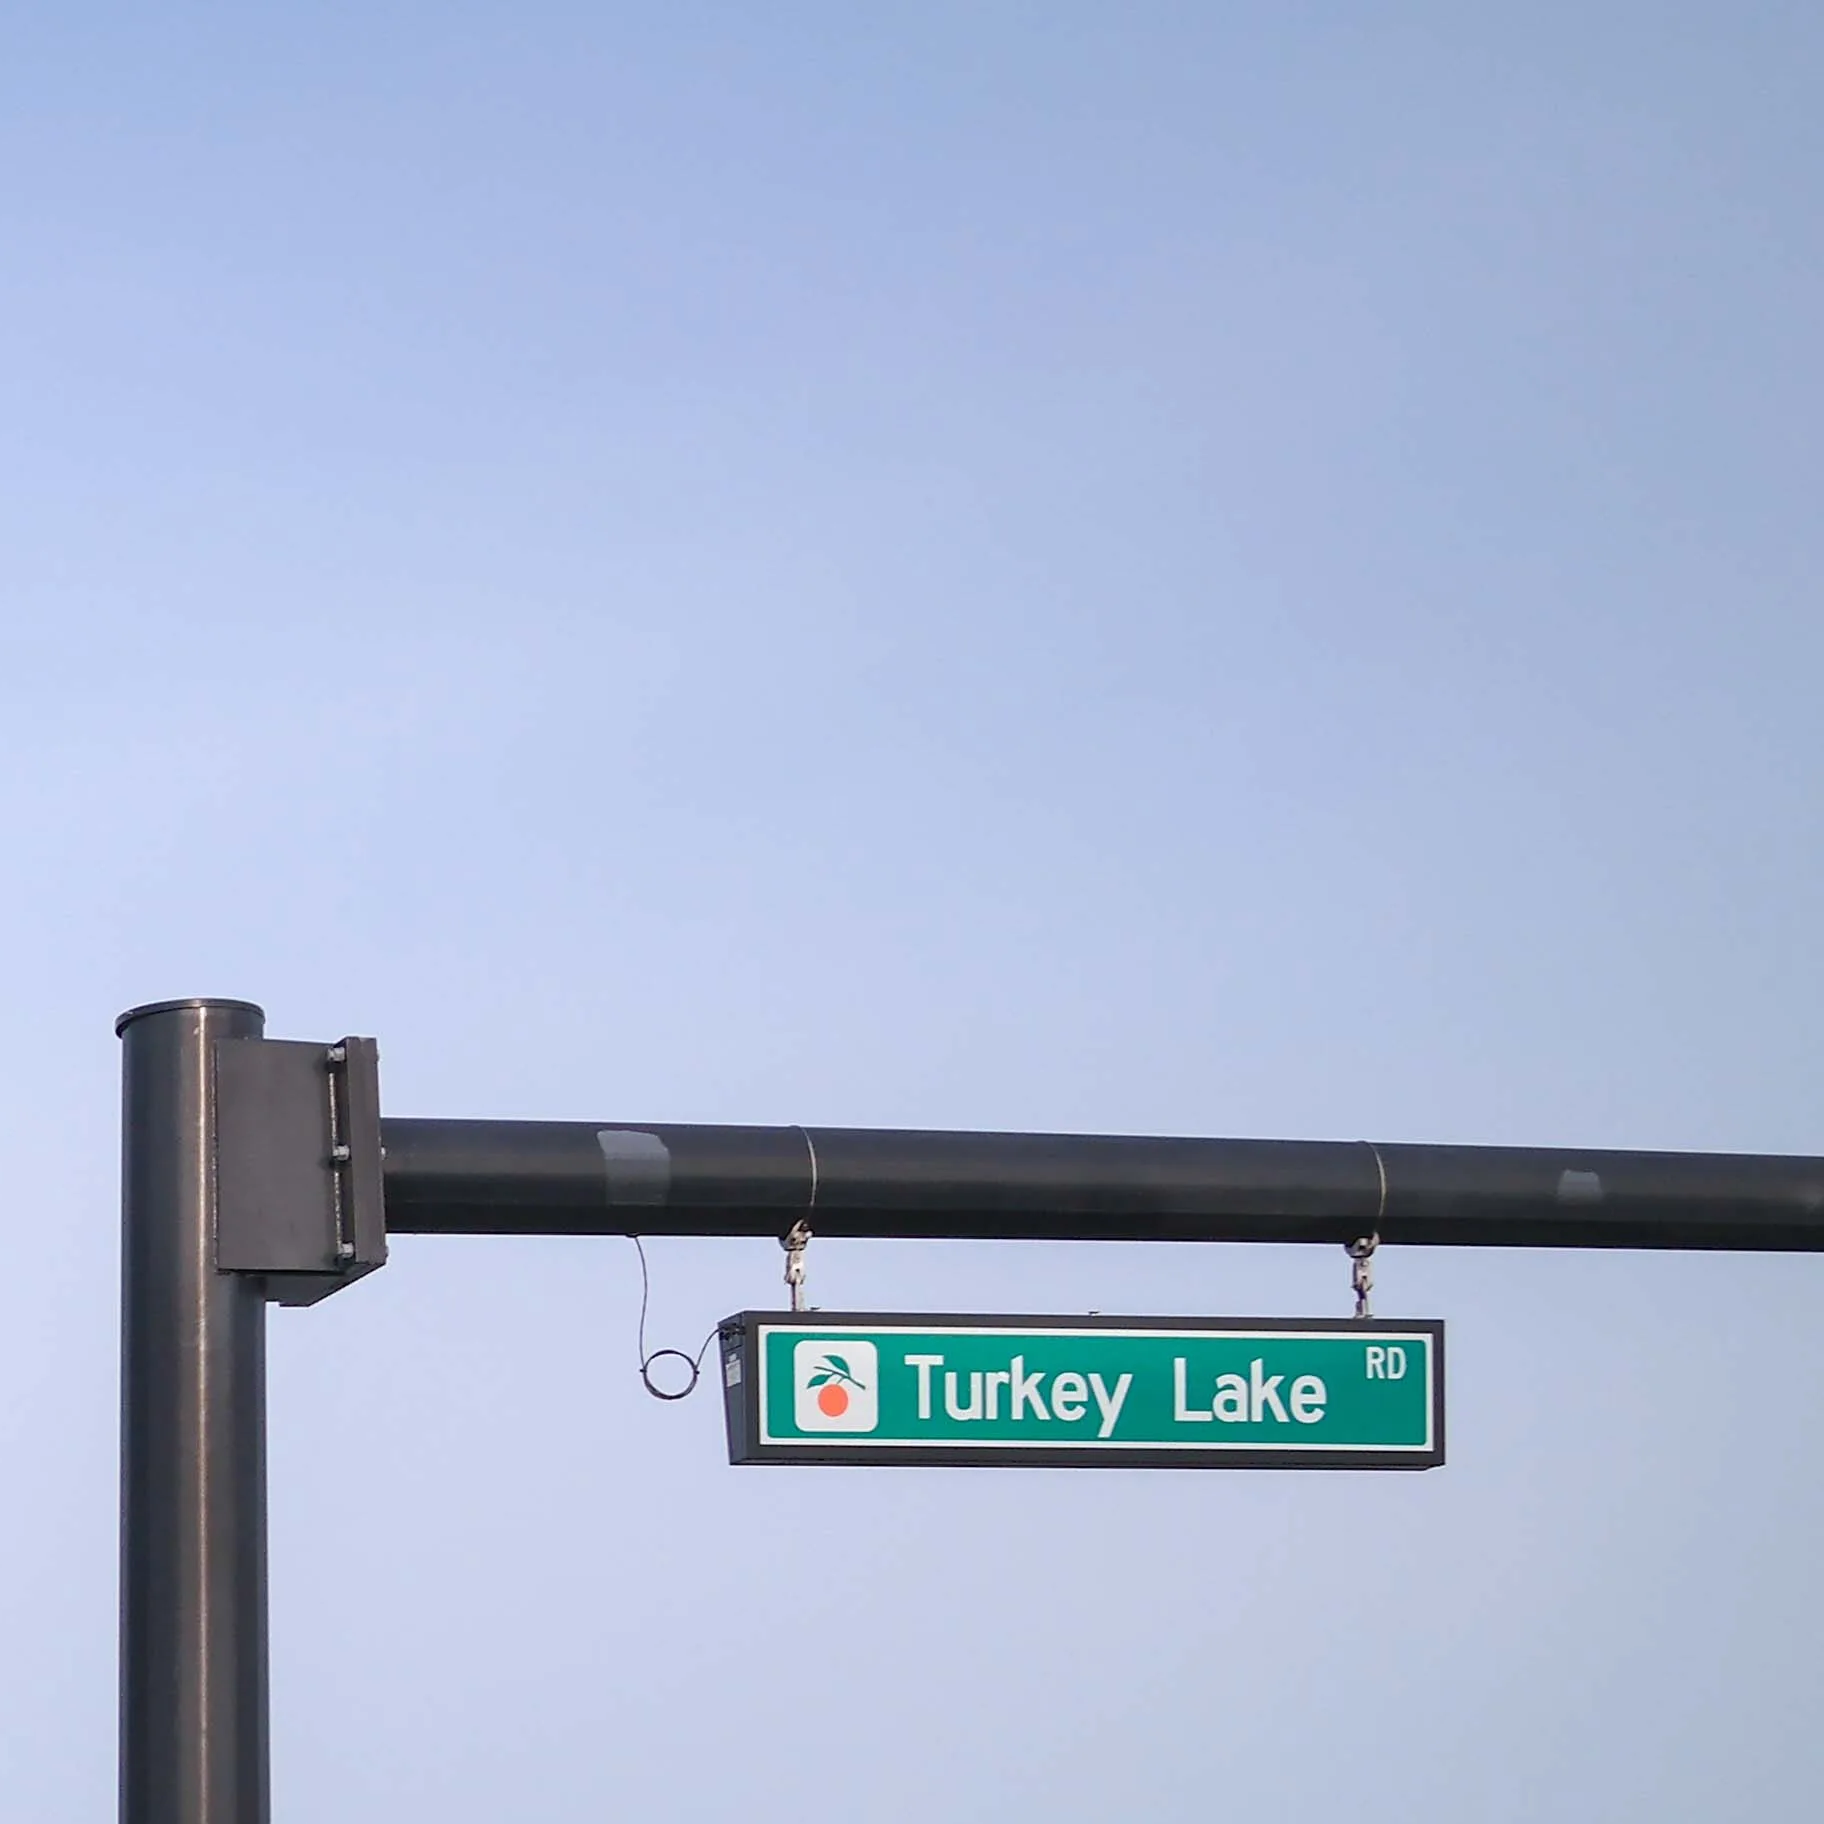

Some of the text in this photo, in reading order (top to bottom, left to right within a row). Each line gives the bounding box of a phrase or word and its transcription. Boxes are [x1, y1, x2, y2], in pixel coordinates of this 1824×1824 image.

[1366, 1346, 1407, 1380] RD
[905, 1354, 1327, 1437] Turkey Lake
